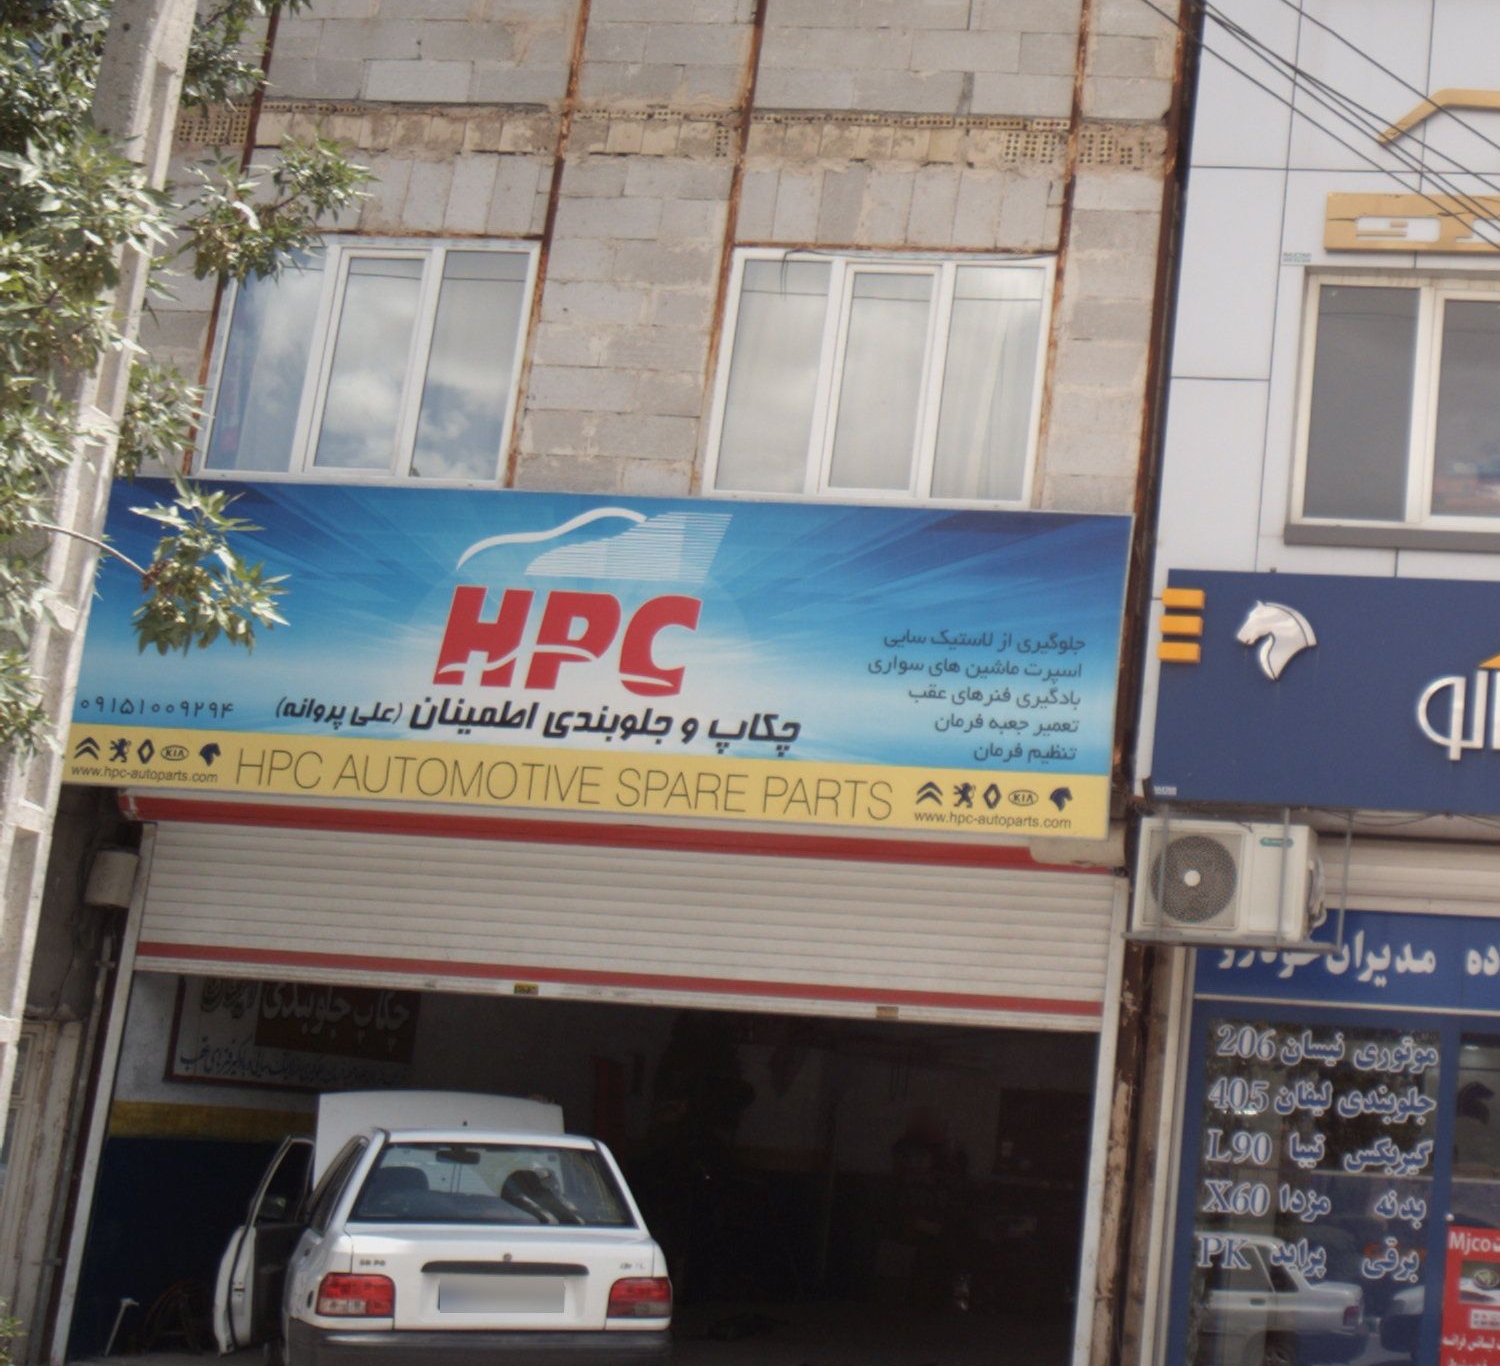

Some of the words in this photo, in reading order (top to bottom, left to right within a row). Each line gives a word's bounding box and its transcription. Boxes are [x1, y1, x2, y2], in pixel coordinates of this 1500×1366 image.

[432, 585, 703, 697] HPC
[930, 629, 995, 650] لاستیک
[997, 633, 1012, 653] از
[1016, 632, 1087, 656] جلوگیری
[867, 655, 925, 676] سواری
[928, 657, 961, 677] های
[965, 659, 1020, 680] ماشین
[1024, 662, 1082, 686] اسپرت
[908, 683, 947, 703] عقب
[1016, 686, 1081, 710] بادگیری
[408, 695, 538, 736] اطمینان
[543, 705, 674, 748] جلوبندی
[680, 715, 701, 744] و
[934, 712, 984, 733] فرمان
[988, 717, 1030, 736] جعبه
[1033, 719, 1080, 737] تعمیر
[708, 710, 802, 758] چکاپ
[973, 741, 1023, 763] فرمان
[1027, 743, 1077, 765] تنظیم
[70, 765, 218, 784] www.hpc-autoparts.com
[236, 747, 324, 791] HPC
[332, 752, 602, 806] AUTOMOTIVE
[615, 766, 749, 813] SPARE
[762, 776, 893, 822] PARTS
[914, 810, 1072, 831] www.hpc-autoparts.com
[1216, 1023, 1277, 1061] 206
[1280, 1030, 1345, 1067] نیسان
[1353, 1036, 1439, 1074] موتوری
[1208, 1076, 1270, 1113] 405
[1337, 1085, 1437, 1125] جلوبندی
[1205, 1128, 1273, 1165] L90
[1288, 1131, 1326, 1169] تیبا
[1343, 1137, 1434, 1176] گیربکس
[1202, 1179, 1271, 1217] X60
[1279, 1183, 1332, 1223] مزدا
[1373, 1189, 1428, 1230] بدنه
[1198, 1236, 1252, 1270] PK
[1269, 1238, 1327, 1279] پراید
[1448, 1229, 1492, 1256] Mjco
[1361, 1236, 1421, 1284] برقی
